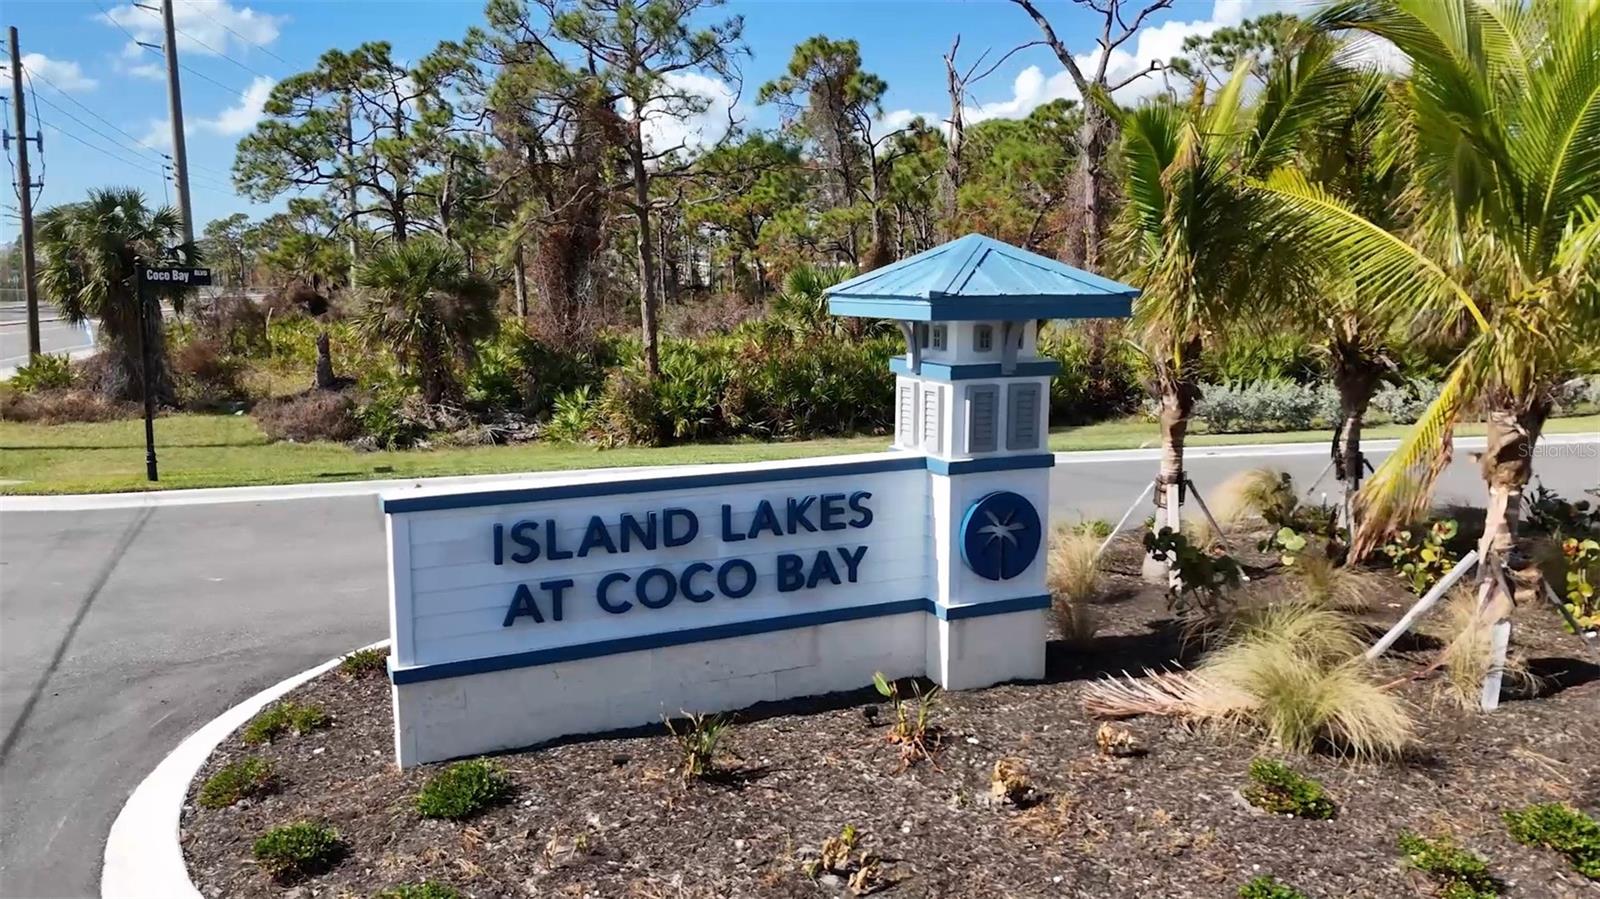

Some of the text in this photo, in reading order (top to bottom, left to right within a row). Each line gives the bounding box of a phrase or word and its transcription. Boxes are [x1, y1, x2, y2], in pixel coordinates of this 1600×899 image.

[146, 269, 170, 281] Coco
[172, 269, 189, 283] Bay
[493, 491, 874, 565] ISLAND LAKES
[503, 546, 868, 627] AT COCO BAY
